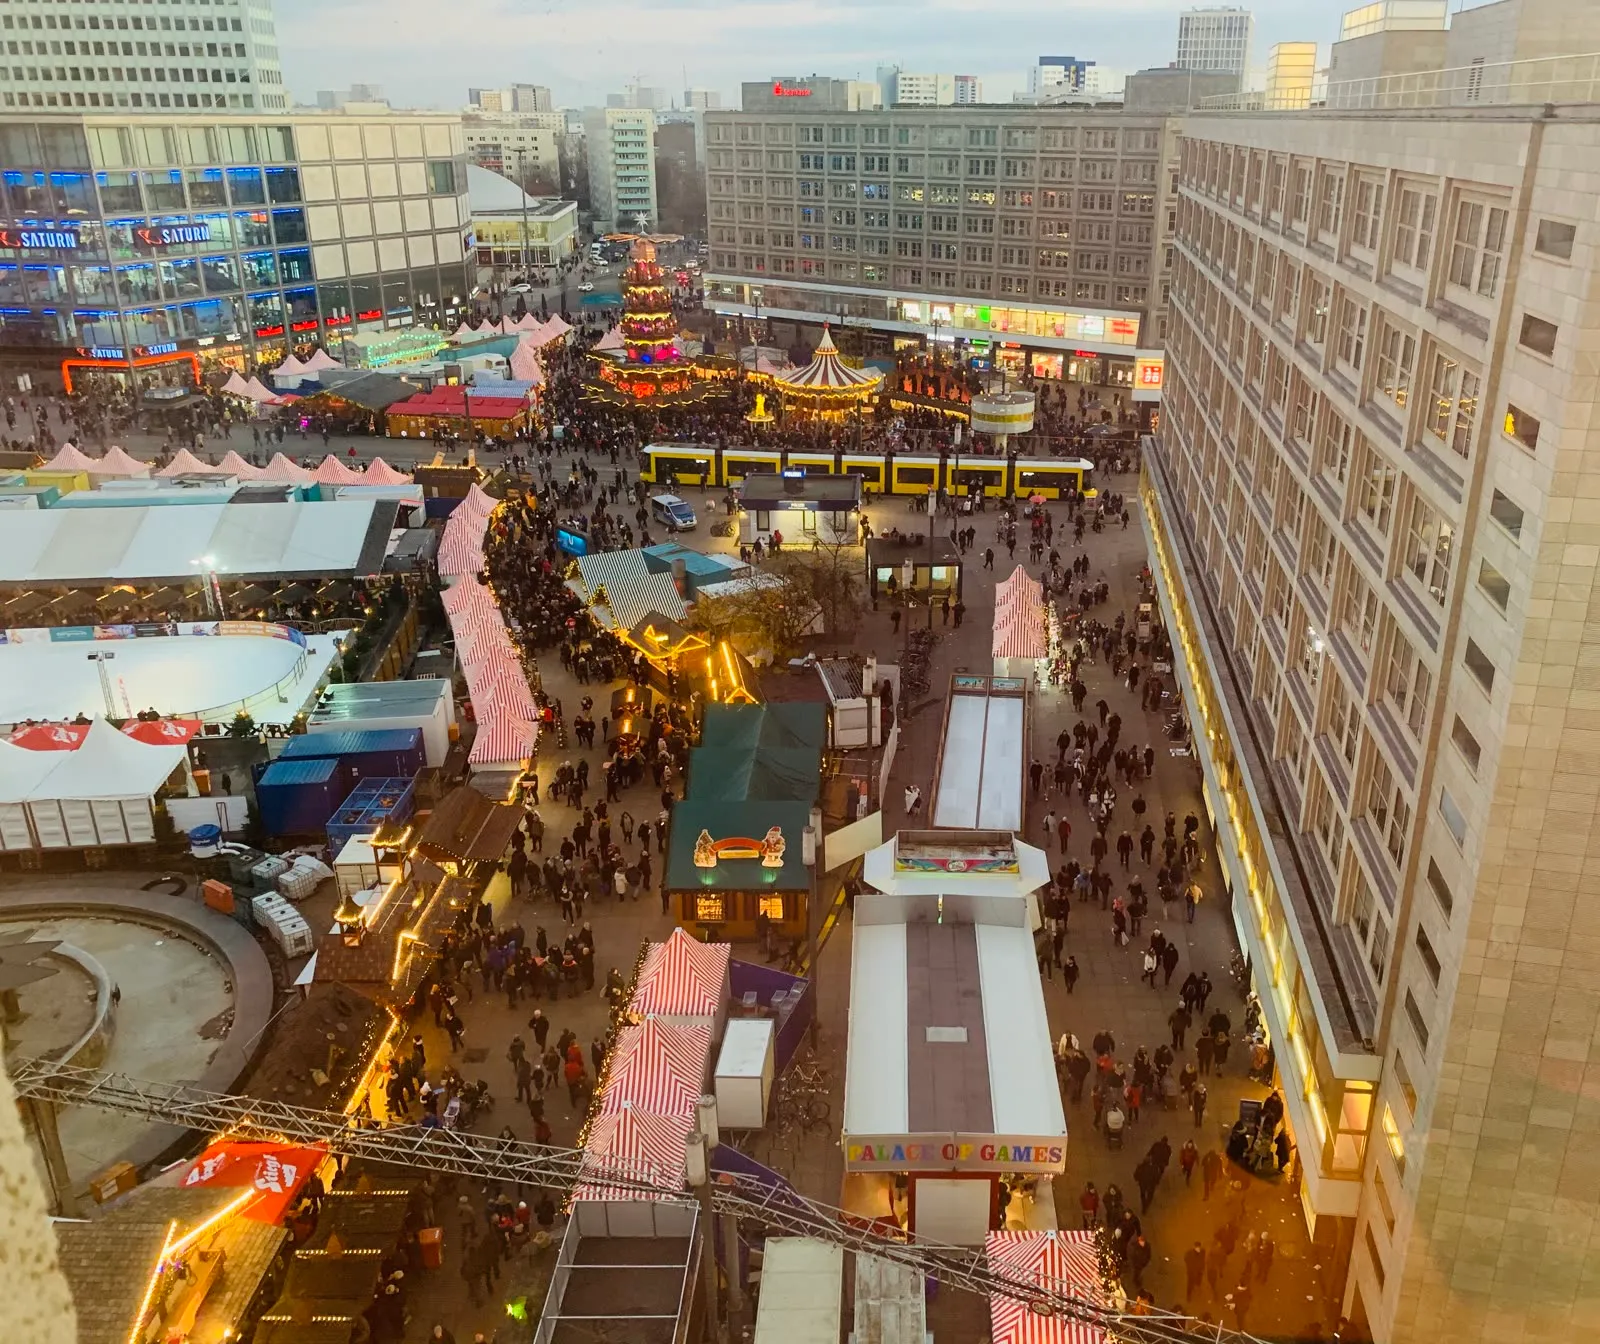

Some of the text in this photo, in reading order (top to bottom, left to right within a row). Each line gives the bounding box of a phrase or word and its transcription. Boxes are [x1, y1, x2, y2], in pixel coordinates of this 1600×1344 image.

[20, 232, 76, 248] SATURN
[162, 226, 210, 244] SATURN
[91, 348, 124, 359] SATURN
[148, 343, 178, 355] SATURN
[848, 1143, 1063, 1163] PALACE OF GAMES
